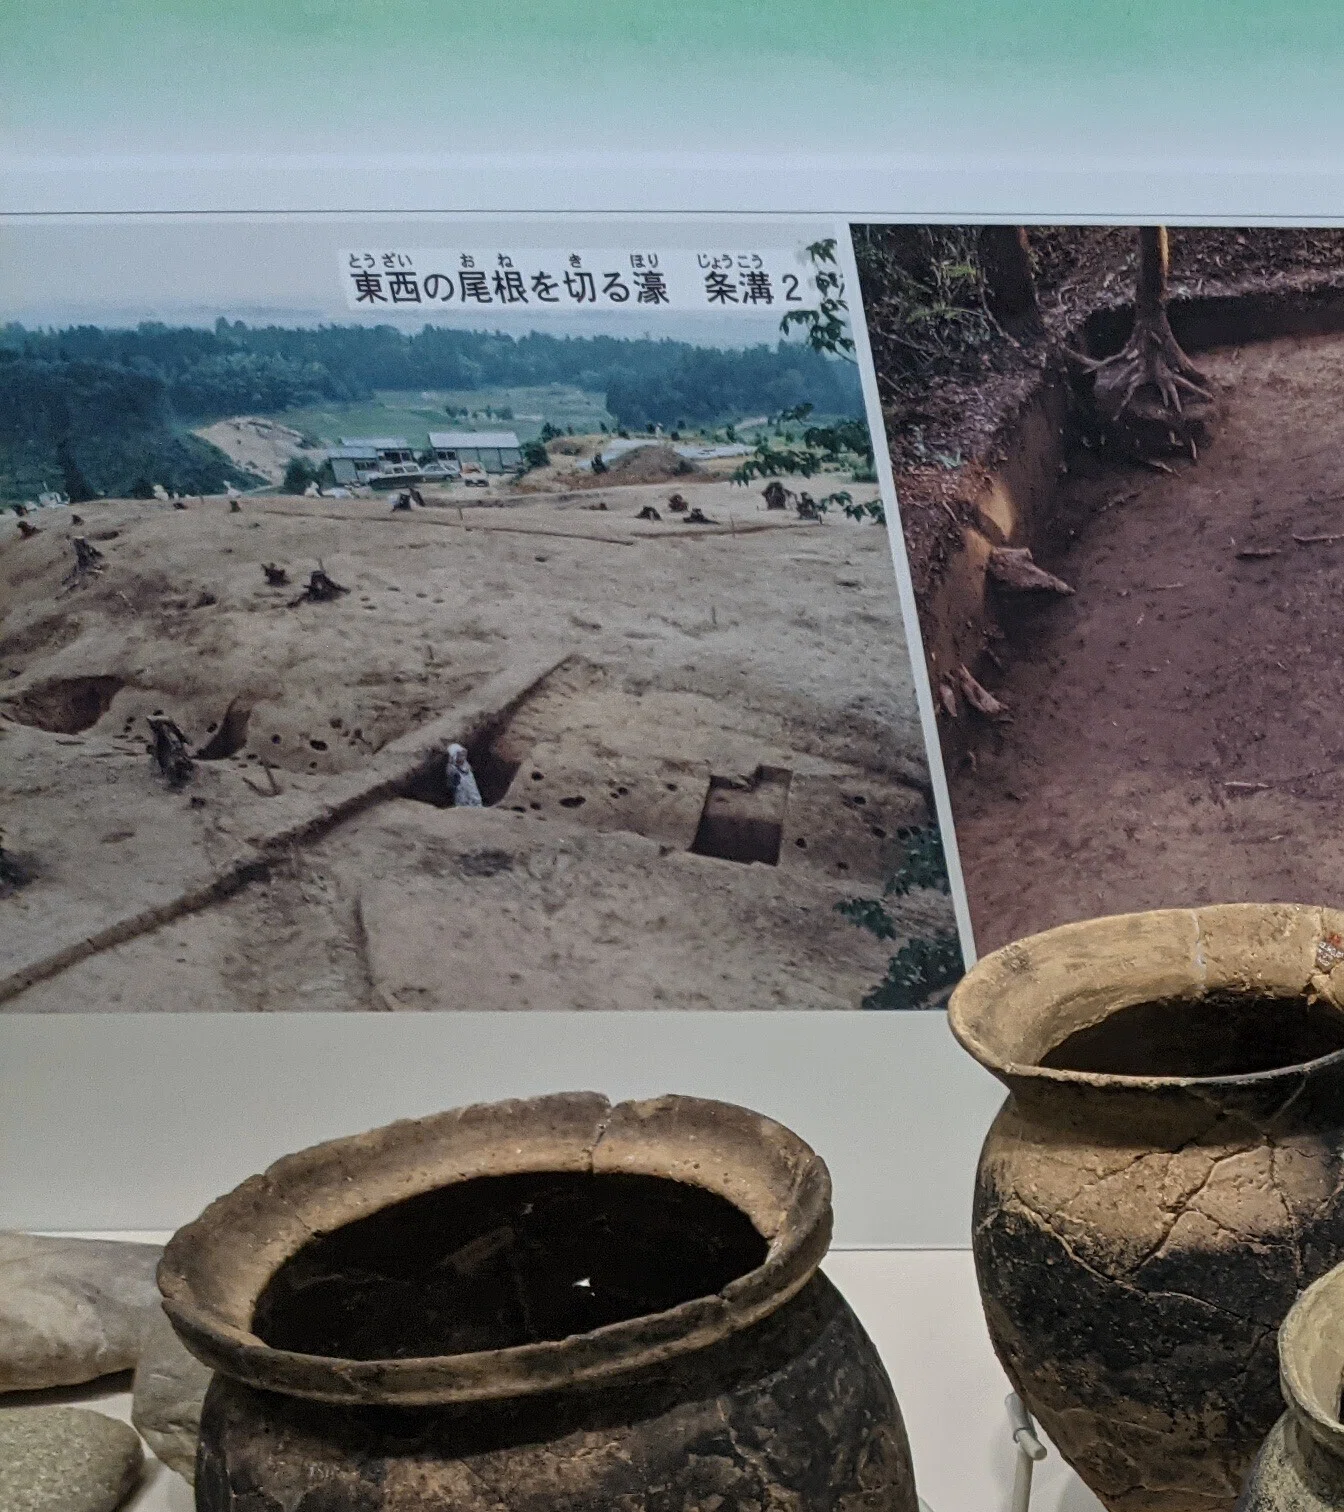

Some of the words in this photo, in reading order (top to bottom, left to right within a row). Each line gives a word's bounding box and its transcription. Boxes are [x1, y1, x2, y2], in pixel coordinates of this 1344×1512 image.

[350, 270, 669, 304] 東西の尾根を切る濠
